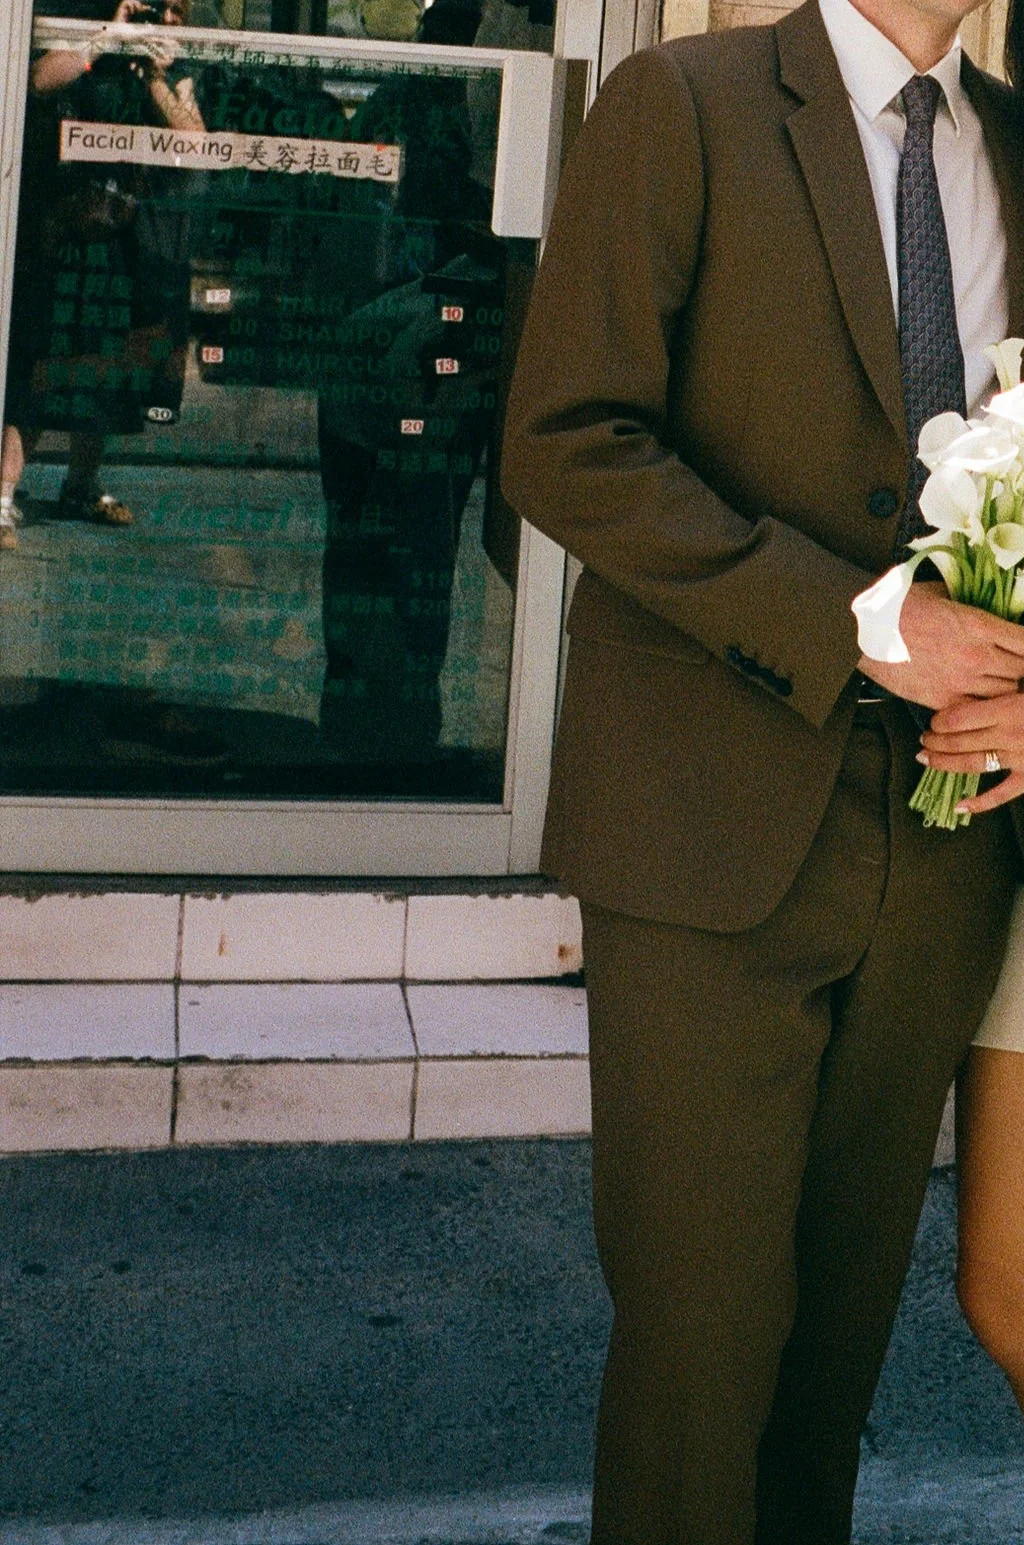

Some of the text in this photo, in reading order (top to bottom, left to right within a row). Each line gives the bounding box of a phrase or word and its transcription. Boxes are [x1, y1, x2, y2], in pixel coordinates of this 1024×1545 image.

[68, 126, 393, 177] Facial Waxing 美容拉面毛
[444, 307, 462, 321] 10
[280, 322, 393, 347] SHAMPO
[203, 347, 222, 361] 15
[437, 358, 457, 373] 13
[402, 420, 423, 433] 20
